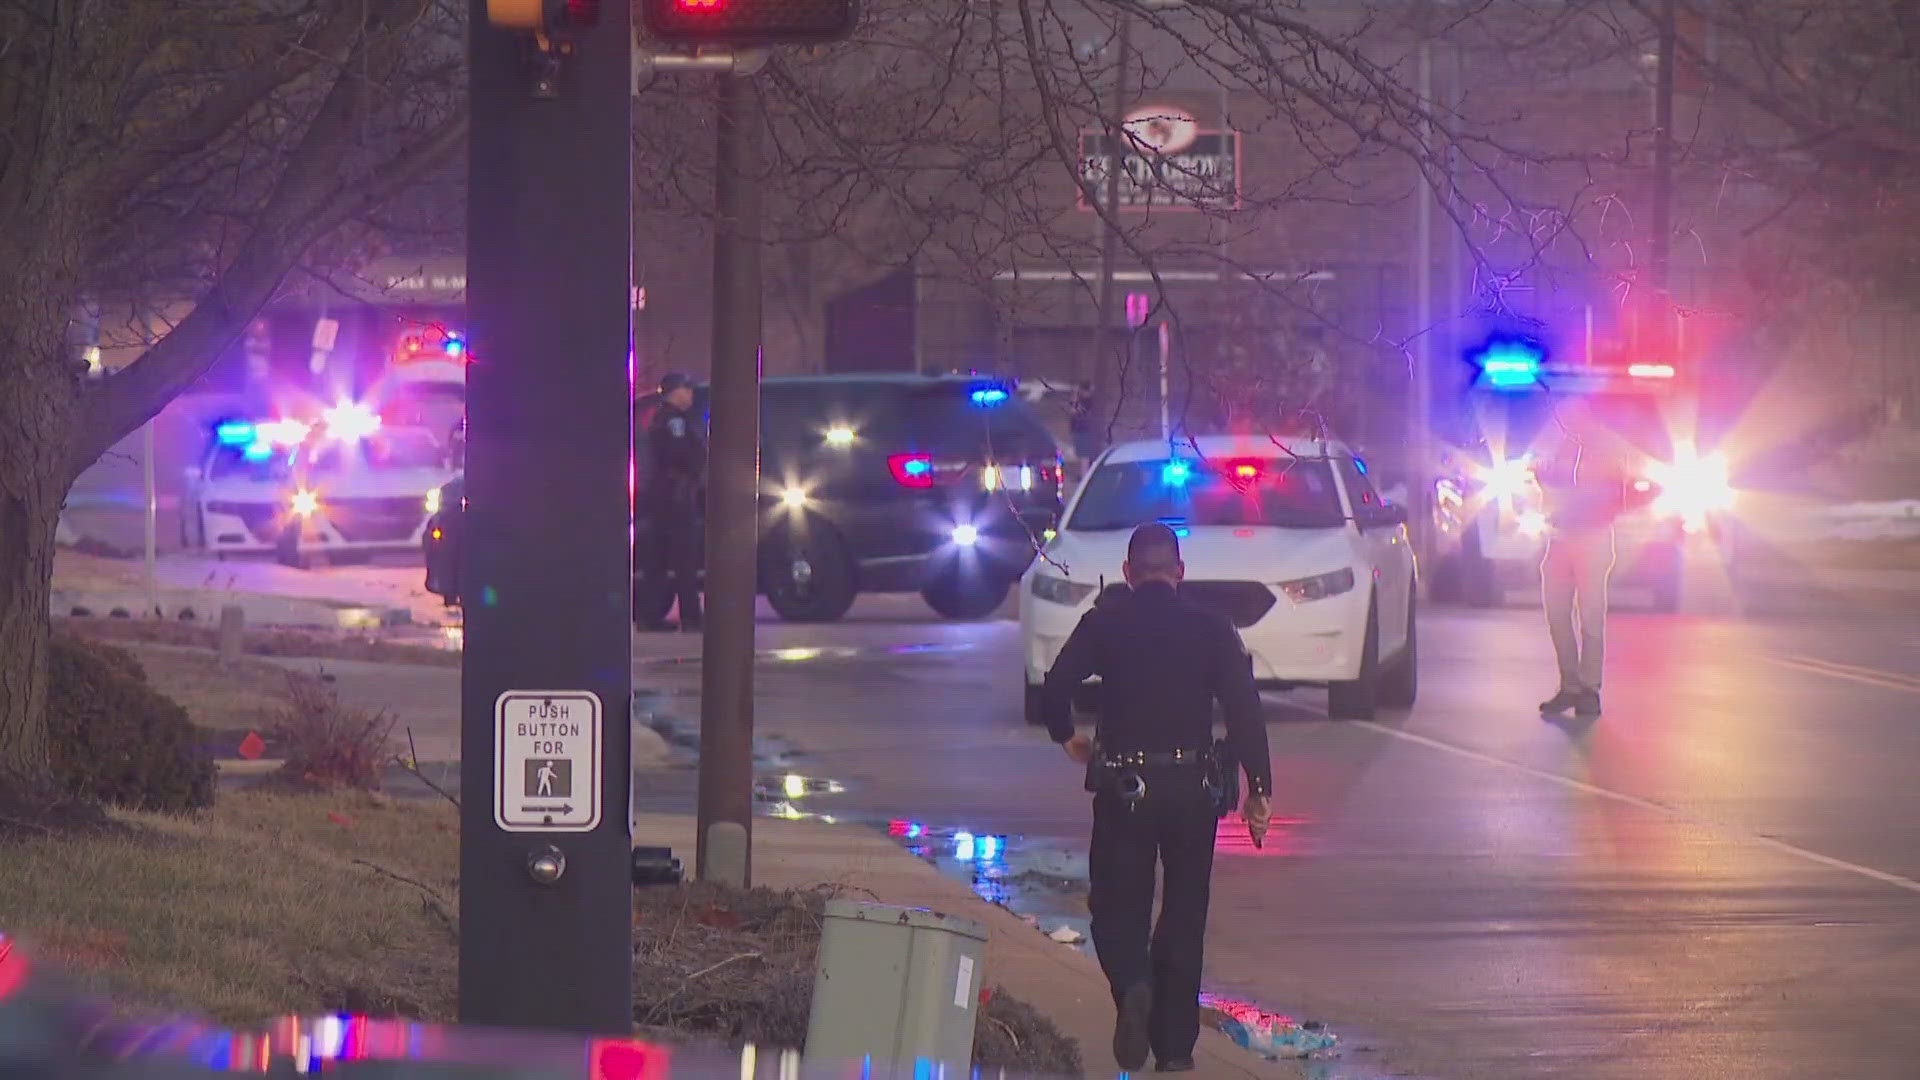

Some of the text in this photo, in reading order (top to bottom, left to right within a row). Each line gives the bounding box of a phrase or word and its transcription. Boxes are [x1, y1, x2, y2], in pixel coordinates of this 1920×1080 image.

[529, 705, 569, 719] PUSH
[518, 723, 579, 737] BUTTON
[534, 741, 563, 754] FOR
